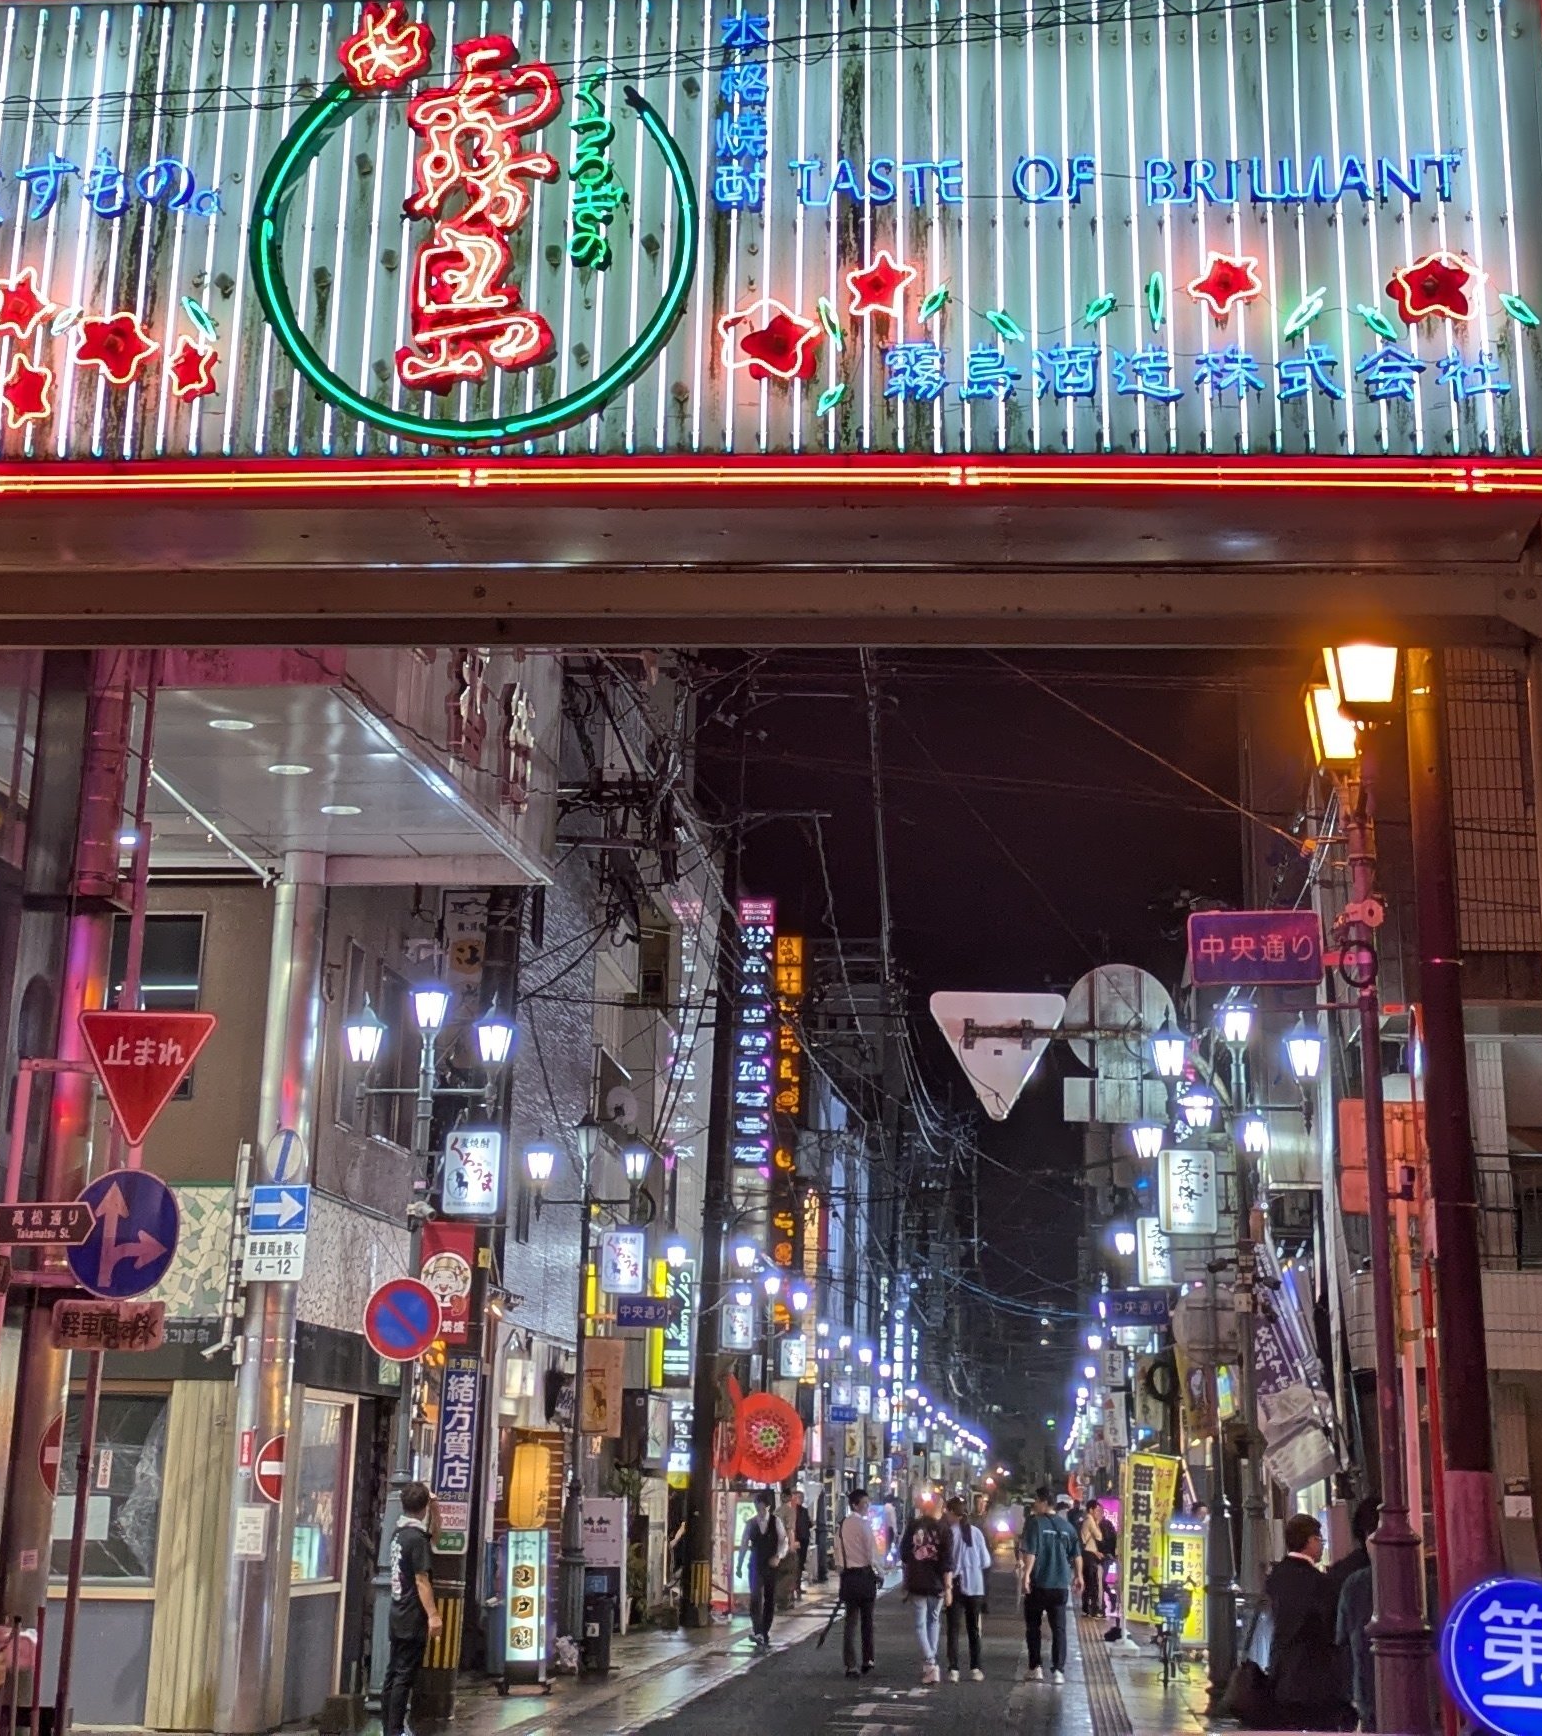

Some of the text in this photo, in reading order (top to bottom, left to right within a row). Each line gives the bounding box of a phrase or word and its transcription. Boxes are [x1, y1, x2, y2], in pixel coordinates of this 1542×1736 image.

[713, 10, 770, 211] 本格焼酎
[789, 150, 1463, 208] TASTE OF BRILLIANT
[396, 37, 564, 395] 霧島
[883, 342, 1512, 402] 霧島酒造株式会社
[1198, 932, 1315, 964] 中央通り
[103, 1037, 186, 1068] 止まれ
[11, 1208, 80, 1227] 高松通り
[16, 1227, 56, 1241] Takamatsu
[248, 1242, 300, 1257] 軽車両を除く
[619, 1304, 667, 1321] 中央通り
[440, 1374, 476, 1489] 緒方質店
[1128, 1464, 1155, 1617] 無料案内所
